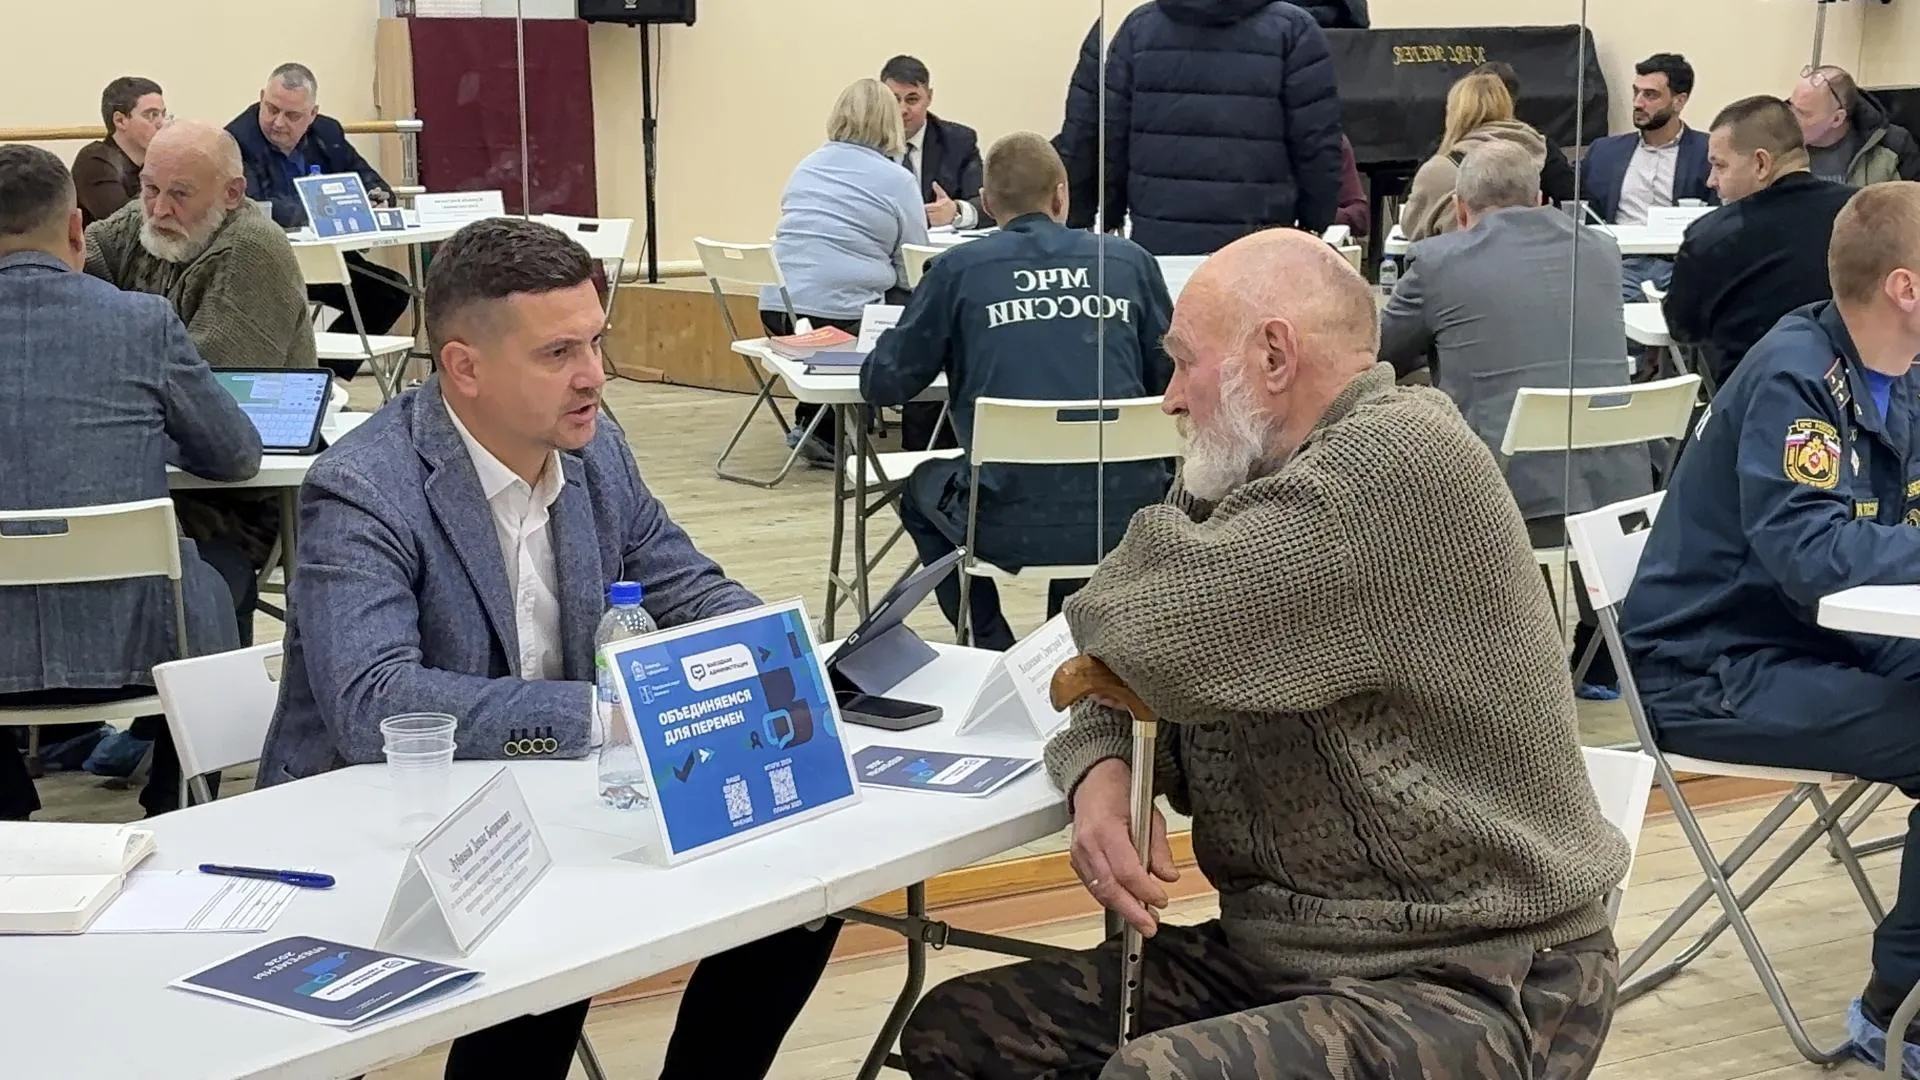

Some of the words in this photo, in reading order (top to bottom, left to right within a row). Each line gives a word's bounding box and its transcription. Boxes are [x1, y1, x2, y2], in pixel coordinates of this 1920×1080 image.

[658, 688, 753, 726] ОБЪЕДИНЯЕМСЯ
[664, 724, 692, 746] ДЛЯ
[691, 710, 745, 737] ПЕРЕМЕН
